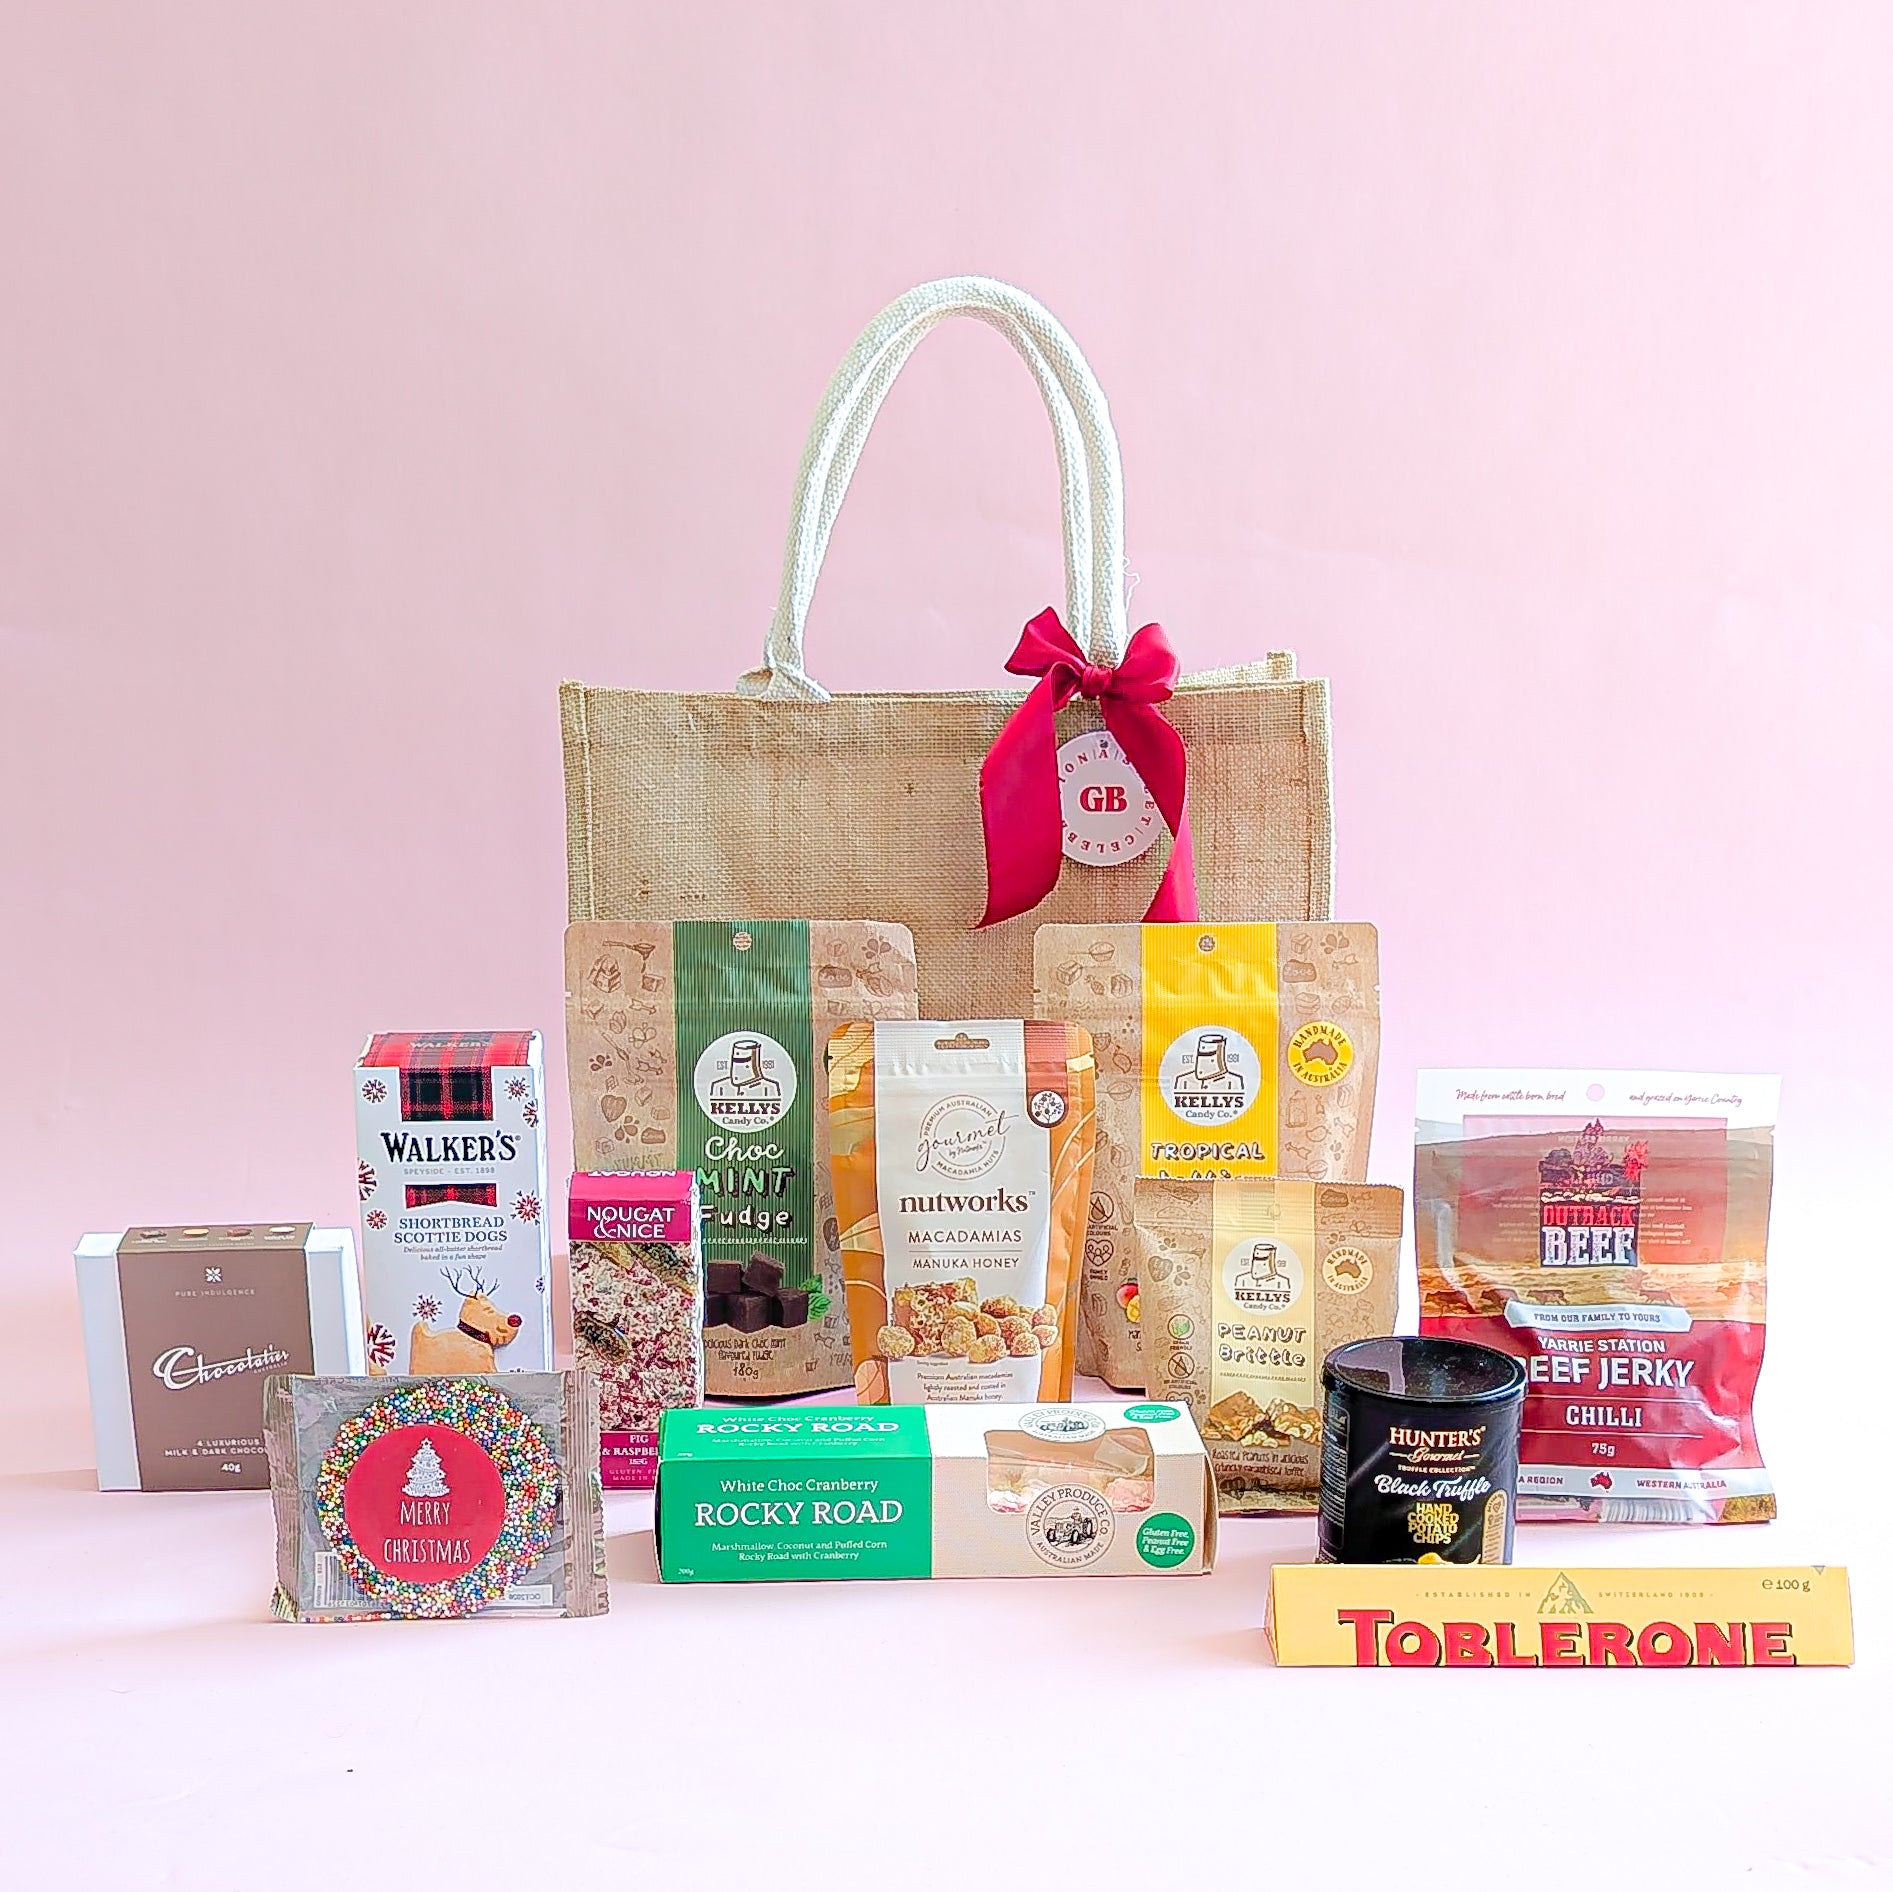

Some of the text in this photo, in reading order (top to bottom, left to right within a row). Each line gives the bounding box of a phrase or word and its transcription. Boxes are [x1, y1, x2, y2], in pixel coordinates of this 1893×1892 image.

[1080, 787, 1127, 812] GB
[1293, 1025, 1346, 1047] HANDMADE
[1301, 1063, 1347, 1083] AUSTRALIA
[711, 1102, 781, 1114] KELLYS
[1174, 1096, 1244, 1108] KELLYS
[722, 1117, 752, 1126] Candy
[924, 1100, 992, 1136] PREMIUM AUSTRALIAN
[1185, 1109, 1232, 1119] Candy Co.
[381, 1130, 516, 1162] WALKER'S
[916, 1110, 1019, 1171] gourmet
[705, 1136, 784, 1162] Choc
[1151, 1142, 1265, 1161] TROPICAL
[936, 1150, 999, 1175] MACADAMIA NUTS
[696, 1166, 796, 1197] MINT
[898, 1187, 1028, 1214] nutworks
[587, 1206, 675, 1222] NOUGAT
[700, 1205, 792, 1231] Fudge
[1543, 1205, 1636, 1227] OUTBACK
[399, 1217, 504, 1229] SHORTBREAD
[394, 1231, 507, 1243] SCOTTIE DOGS
[908, 1229, 1022, 1243] MACADAMIAS
[1541, 1226, 1635, 1265] BEEF
[912, 1256, 1019, 1269] MANUKA HONEY
[1235, 1291, 1290, 1303] KELLYS
[1243, 1302, 1267, 1310] Candy
[1534, 1313, 1660, 1322] FROM OUR FAMILY TO YOURS
[1218, 1322, 1306, 1343] PEANUT
[1538, 1336, 1666, 1353] YARRIE STATION
[1219, 1343, 1305, 1367] Brittle
[733, 1362, 759, 1380] 180g
[1598, 1356, 1694, 1390] JERKY
[1566, 1404, 1642, 1427] CHILLI
[697, 1422, 899, 1434] ROCKY ROAD
[206, 1438, 260, 1447] LUXURIOUS
[630, 1435, 649, 1443] FIG
[1389, 1426, 1482, 1448] HUNTER'S
[1408, 1447, 1463, 1463] Gourmet
[1592, 1443, 1615, 1457] 75g
[221, 1463, 241, 1473] 40g
[720, 1478, 878, 1493] White Choc Cranberry
[1374, 1474, 1492, 1501] Black Truffle
[1527, 1476, 1563, 1484] REGION
[1637, 1479, 1682, 1489] WESTERN
[399, 1501, 451, 1526] MERRY
[694, 1500, 903, 1527] ROCKY ROAD
[1031, 1488, 1108, 1535] VALLEY PRODUCE
[1416, 1502, 1453, 1515] HAND
[1407, 1512, 1459, 1524] COOKED
[1408, 1522, 1458, 1533] POTATO
[777, 1542, 814, 1550] Coconut
[835, 1541, 863, 1549] Puffed
[865, 1540, 887, 1549] Corn
[1413, 1532, 1452, 1544] CHIPS
[383, 1538, 471, 1564] CHRISTMAS
[739, 1551, 859, 1562] Rocky Road with Cranberry
[1036, 1541, 1103, 1563] AUSTRALIAN MADE
[1150, 1546, 1165, 1556] Egg
[1338, 1609, 1797, 1666] TOBLERONE
